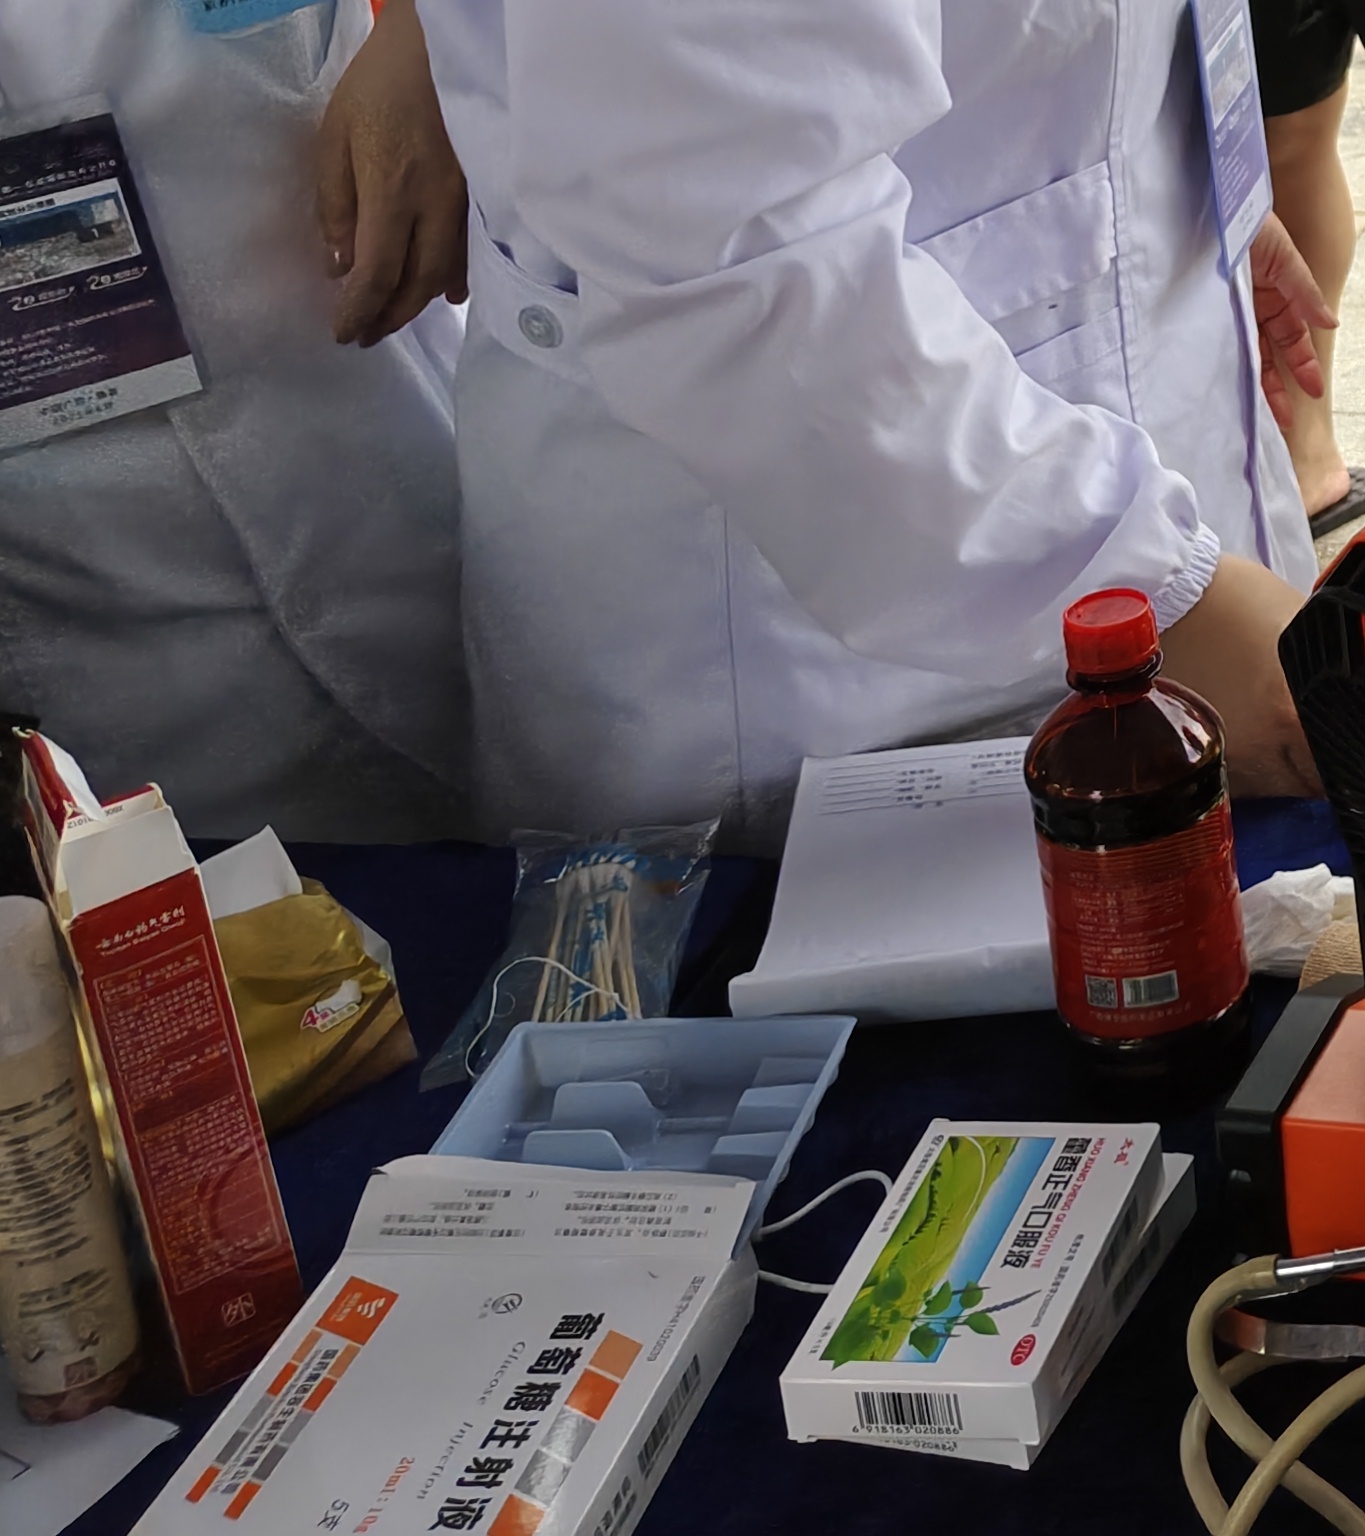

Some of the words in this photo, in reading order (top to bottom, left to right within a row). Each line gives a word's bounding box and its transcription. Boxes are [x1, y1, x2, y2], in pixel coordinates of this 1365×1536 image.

[999, 1136, 1093, 1270] 藿香正气口服液
[475, 1340, 527, 1407] Glucose
[1010, 1336, 1036, 1364] OTC
[427, 1313, 606, 1532] 葡萄糖注射液
[415, 1421, 474, 1501] Injection
[316, 1497, 351, 1532] 5支
